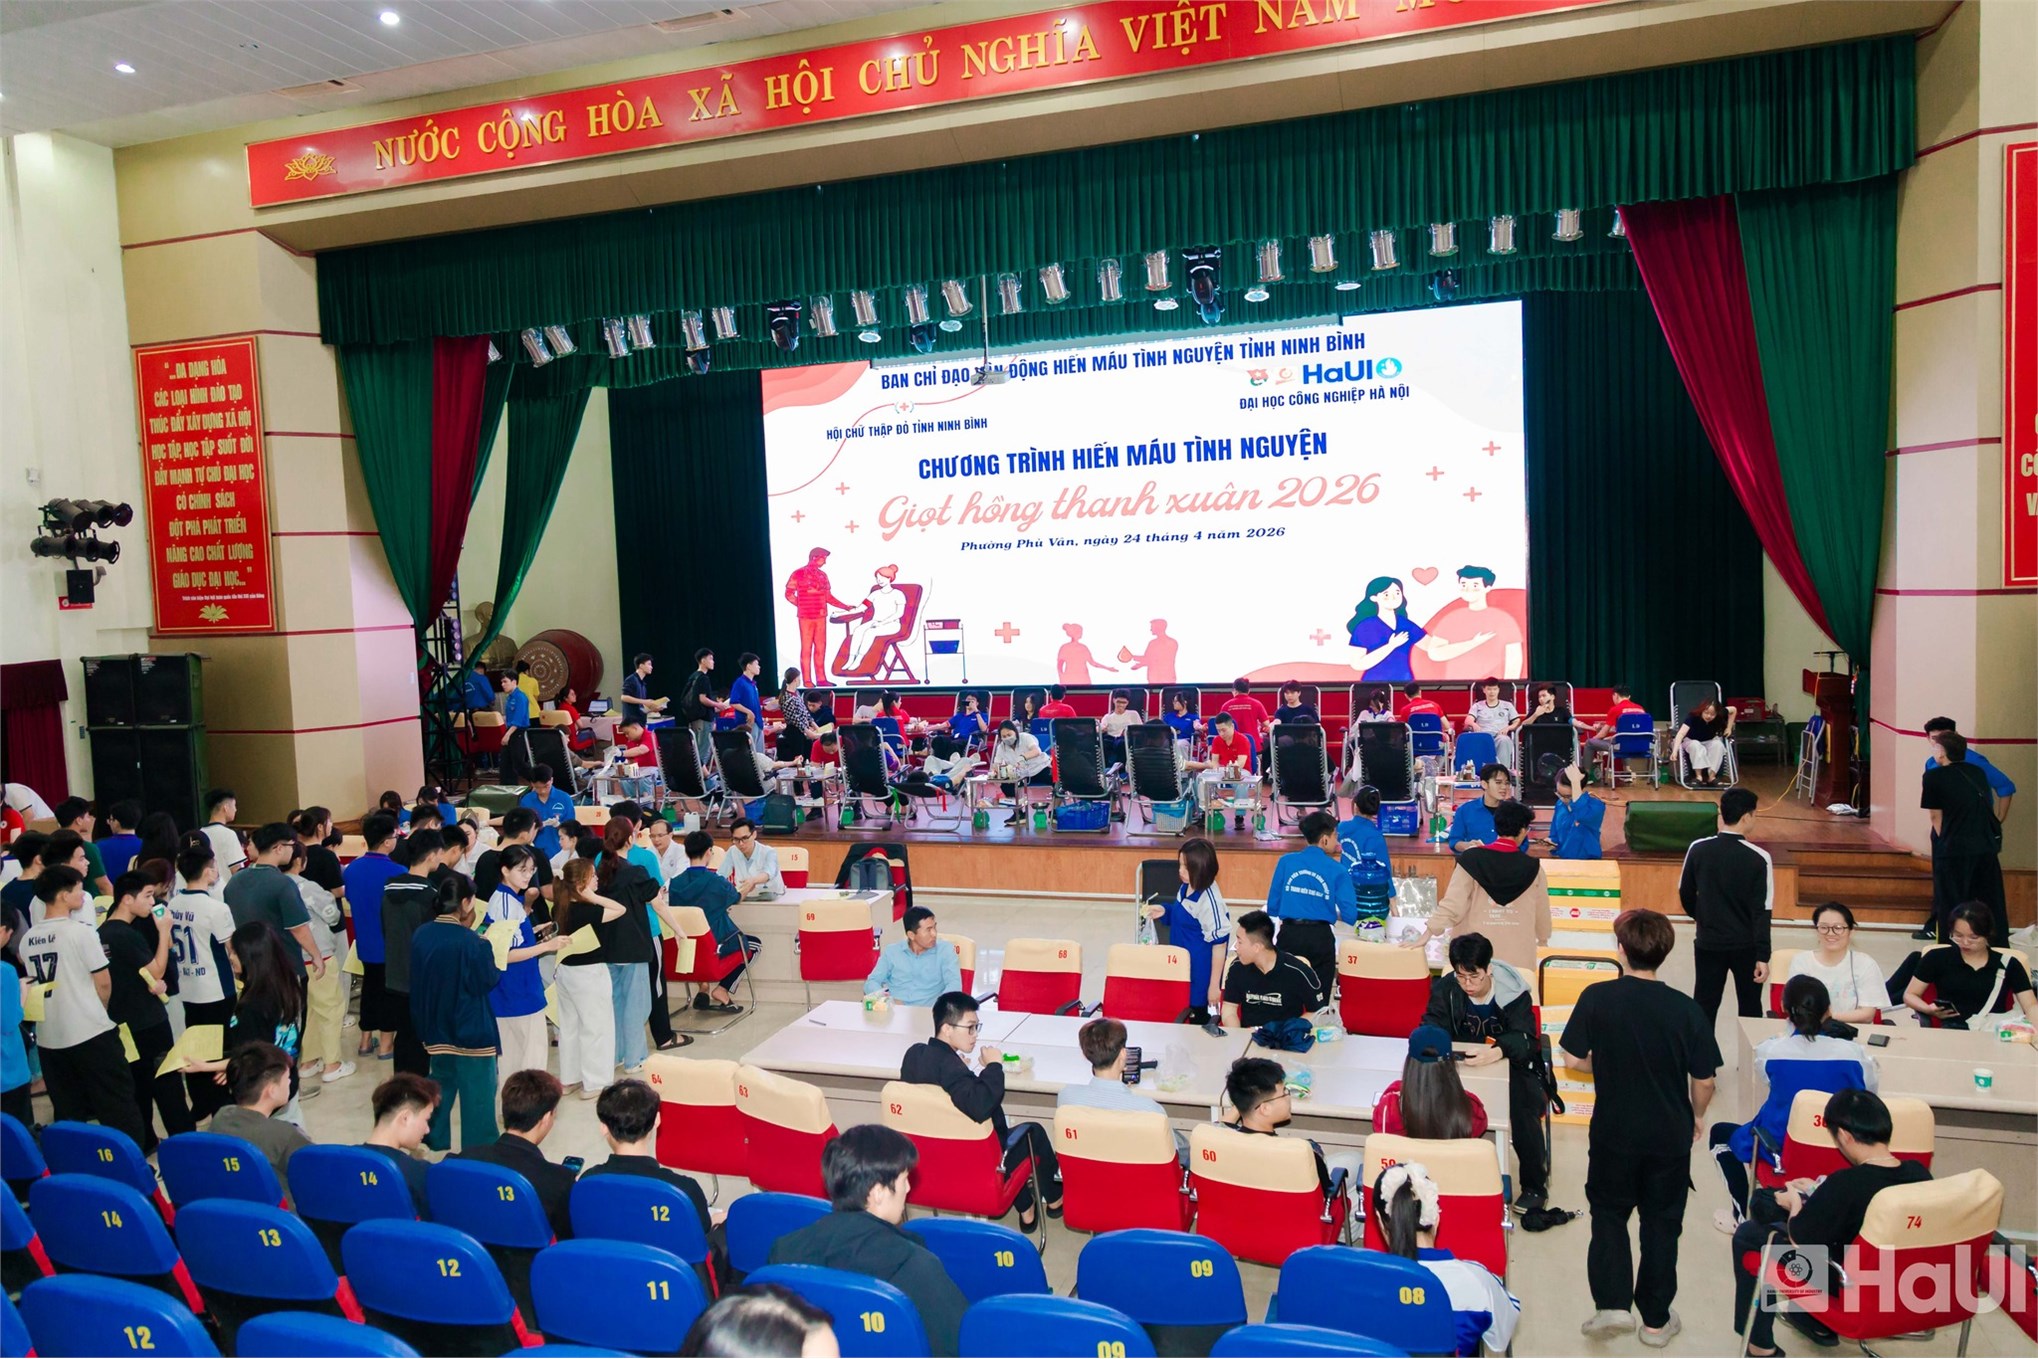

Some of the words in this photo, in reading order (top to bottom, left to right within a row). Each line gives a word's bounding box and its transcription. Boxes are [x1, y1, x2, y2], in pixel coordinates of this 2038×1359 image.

[372, 119, 460, 170] NƯỚC
[478, 108, 567, 159] CỘNG
[587, 90, 663, 137] HÒA
[687, 73, 741, 121] XÃ
[764, 58, 835, 114] HỘI
[859, 35, 940, 95] CHỦ
[961, 17, 1100, 79] NGHĨA
[1120, 0, 1227, 55] VIỆT
[1255, 0, 1360, 33] NAM
[881, 372, 909, 389] BAN
[914, 368, 937, 387] CHỈ
[941, 367, 970, 388] ĐẠO
[1009, 359, 1048, 381] ĐỘNG
[1054, 353, 1087, 374] HIẾN
[1092, 348, 1127, 371] MÁU
[1133, 347, 1167, 368] TÌNH
[1173, 341, 1234, 365] NGUYỆN
[1239, 337, 1275, 359] TỈNH
[1282, 336, 1320, 355] NINH
[1327, 332, 1365, 351] BÌNH
[1303, 359, 1372, 384] HaUI
[1239, 397, 1258, 411] ĐẠI
[1262, 396, 1285, 410] HỌC
[1289, 390, 1319, 407] CÔNG
[1324, 387, 1365, 403] NGHIỆP
[1370, 385, 1386, 400] HÀ
[1390, 383, 1410, 399] NỘI
[826, 427, 843, 442] HỘI
[845, 425, 865, 439] CHỮ
[869, 425, 893, 440] THẬP
[896, 421, 909, 435] ĐỎ
[913, 419, 934, 433] TỈNH
[937, 420, 960, 432] NINH
[964, 417, 988, 430] BÌNH
[918, 454, 1000, 479] CHƯƠNG
[1006, 446, 1065, 474] TRÌNH
[1073, 441, 1118, 469] HIẾN
[1127, 438, 1176, 466] MÁU
[1184, 435, 1232, 463] TÌNH
[1240, 428, 1328, 461] NGUYỆN
[878, 494, 953, 541] Giọt
[958, 490, 1043, 532] hồng
[1051, 481, 1159, 519] thanh
[1165, 481, 1263, 514] xuân
[1268, 472, 1381, 509] 2026
[961, 540, 1012, 551] Phường
[1084, 535, 1119, 547] ngày
[1124, 533, 1141, 544] 24
[1146, 532, 1189, 543] tháng
[1194, 531, 1203, 541] 4
[1208, 530, 1240, 540] năm
[1247, 527, 1286, 538] 2026
[791, 853, 799, 861] 15
[170, 924, 199, 965] 51
[1058, 949, 1068, 959] 68
[1167, 954, 1178, 964] 14
[1346, 955, 1357, 964] 37
[29, 952, 58, 998] 17
[651, 1073, 663, 1085] 64
[738, 1084, 749, 1098] 63
[890, 1103, 903, 1116] 62
[1065, 1127, 1078, 1140] 61
[97, 1149, 113, 1162] 16
[1202, 1149, 1217, 1162] 60
[223, 1158, 240, 1172] 15
[360, 1171, 378, 1186] 14
[497, 1186, 515, 1201] 13
[102, 1211, 122, 1228] 14
[651, 1206, 670, 1221] 12
[1907, 1216, 1922, 1229] 74
[258, 1229, 282, 1246] 13
[994, 1251, 1014, 1267] 10
[437, 1259, 461, 1277] 12
[1190, 1259, 1213, 1278] 09
[647, 1281, 669, 1301] 11
[1399, 1286, 1425, 1305] 08
[860, 1312, 885, 1333] 10
[124, 1326, 155, 1350] 12
[1097, 1340, 1126, 1358] 09
